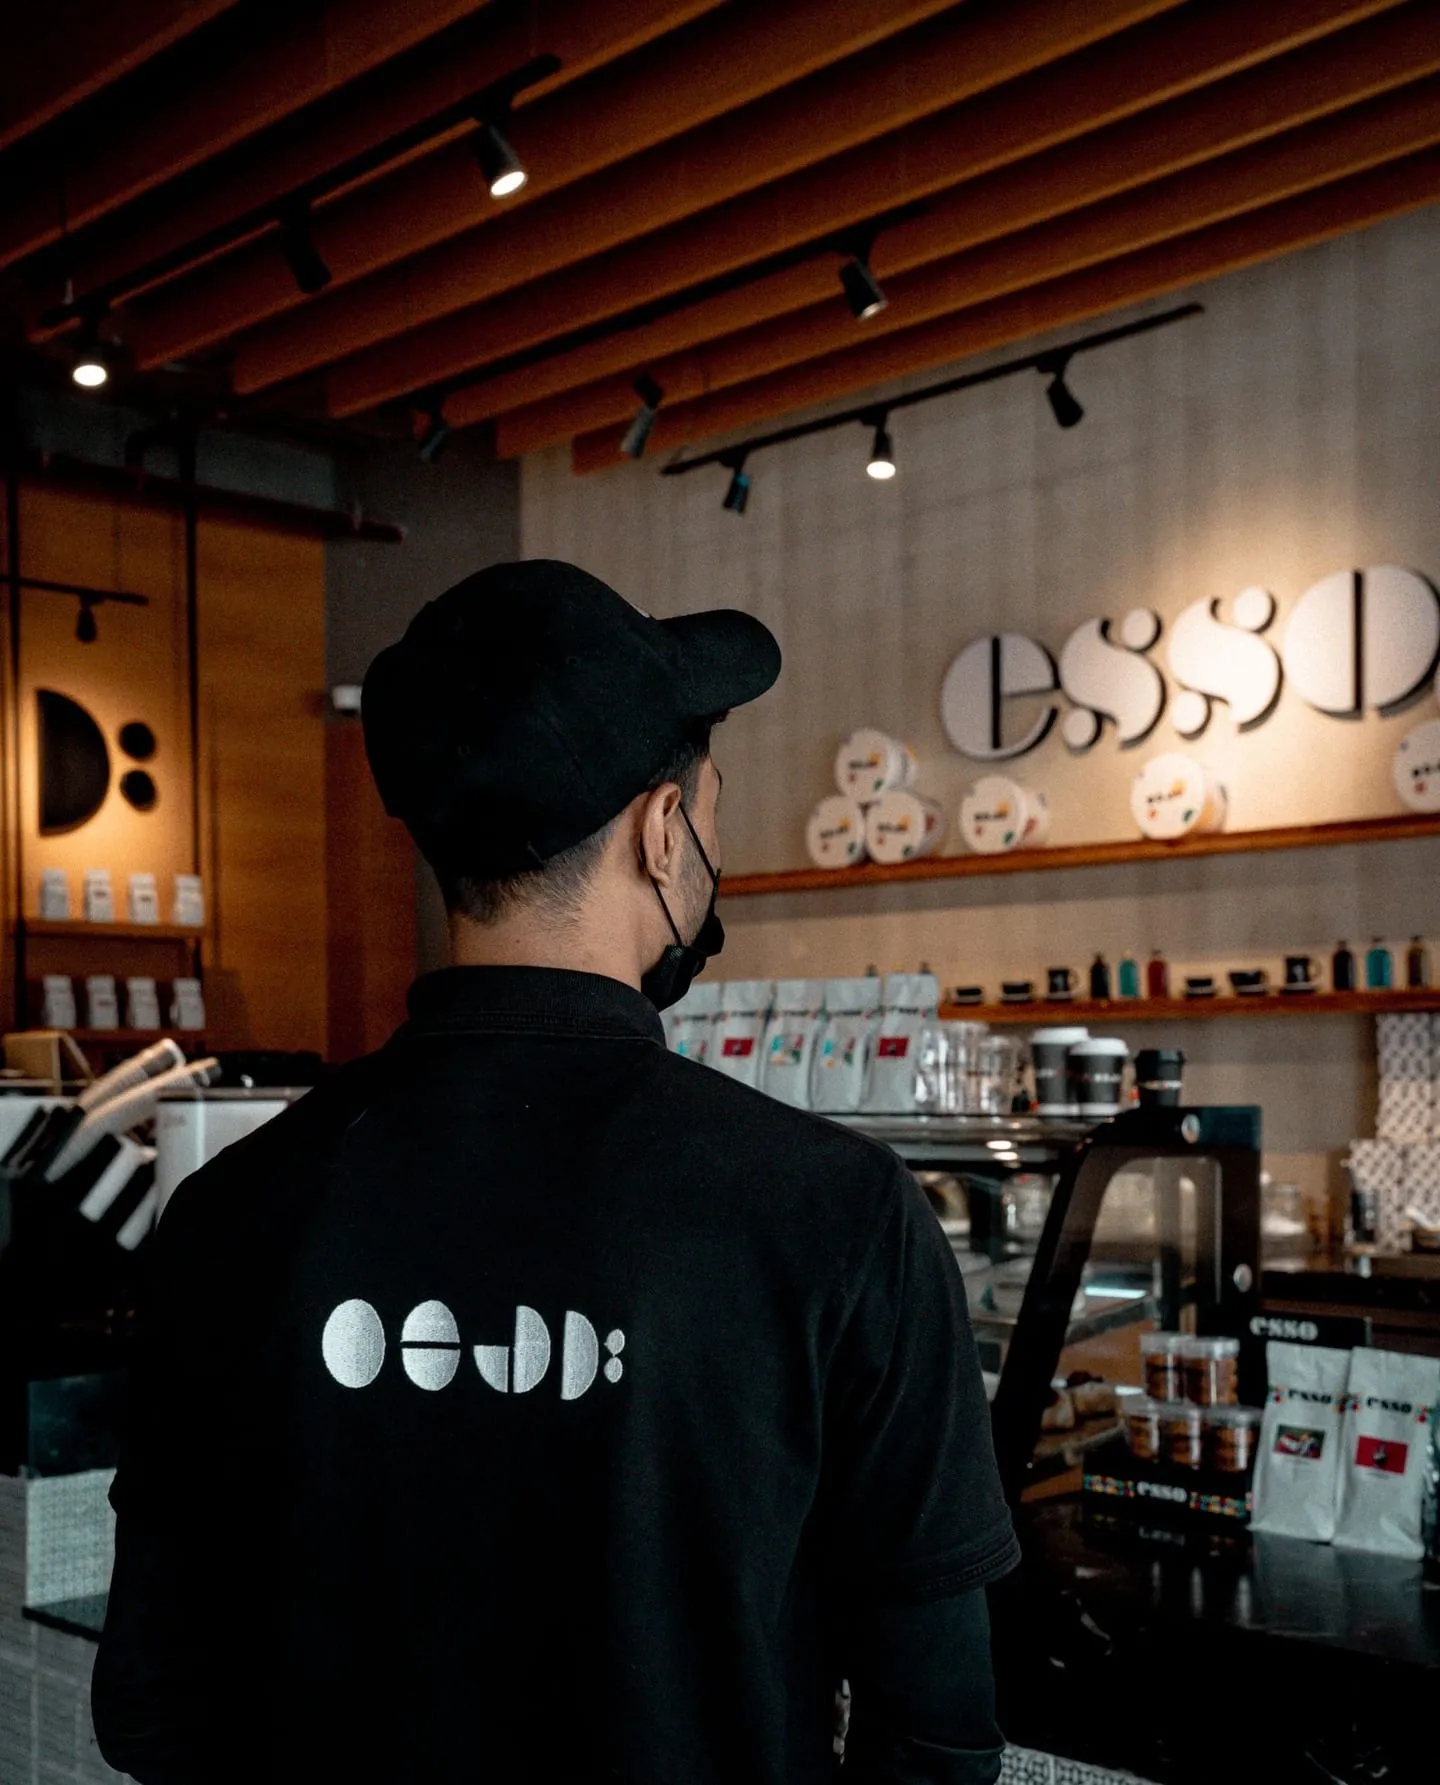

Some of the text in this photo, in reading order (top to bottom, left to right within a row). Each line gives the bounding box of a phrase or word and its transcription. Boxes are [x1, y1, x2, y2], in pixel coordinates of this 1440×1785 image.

[941, 564, 1440, 761] esso
[1250, 1316, 1318, 1341] esso
[1136, 1481, 1188, 1503] esso
